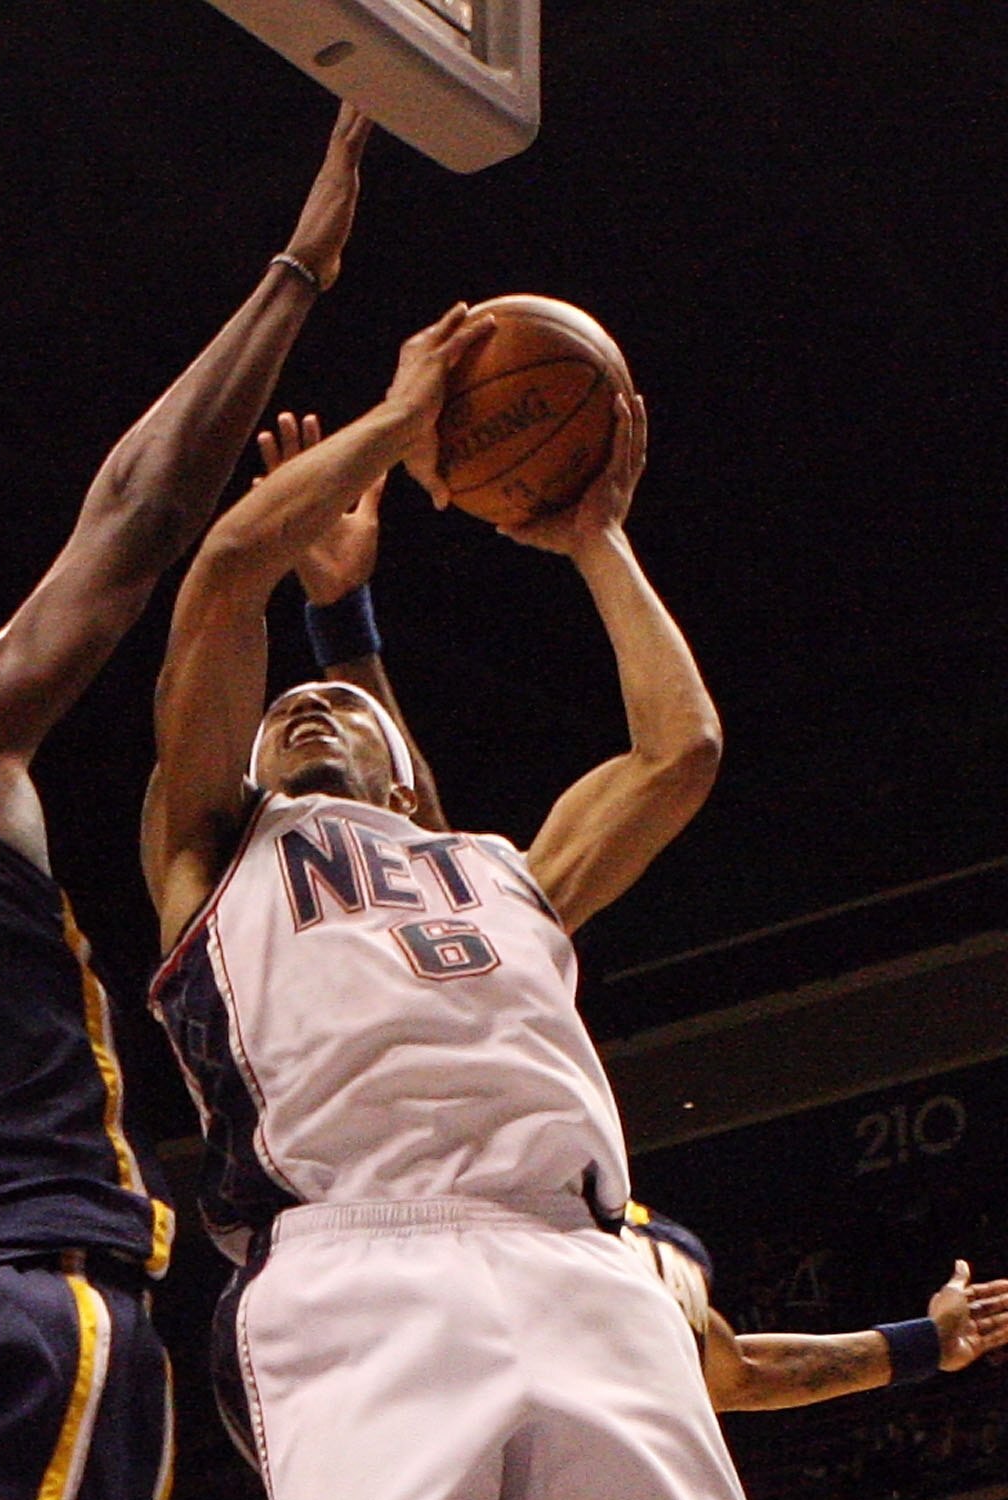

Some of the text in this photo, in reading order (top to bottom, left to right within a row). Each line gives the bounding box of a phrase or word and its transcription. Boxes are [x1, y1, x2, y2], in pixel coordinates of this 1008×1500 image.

[275, 817, 552, 933] NET
[390, 919, 502, 981] 6
[855, 1095, 967, 1174] 210
